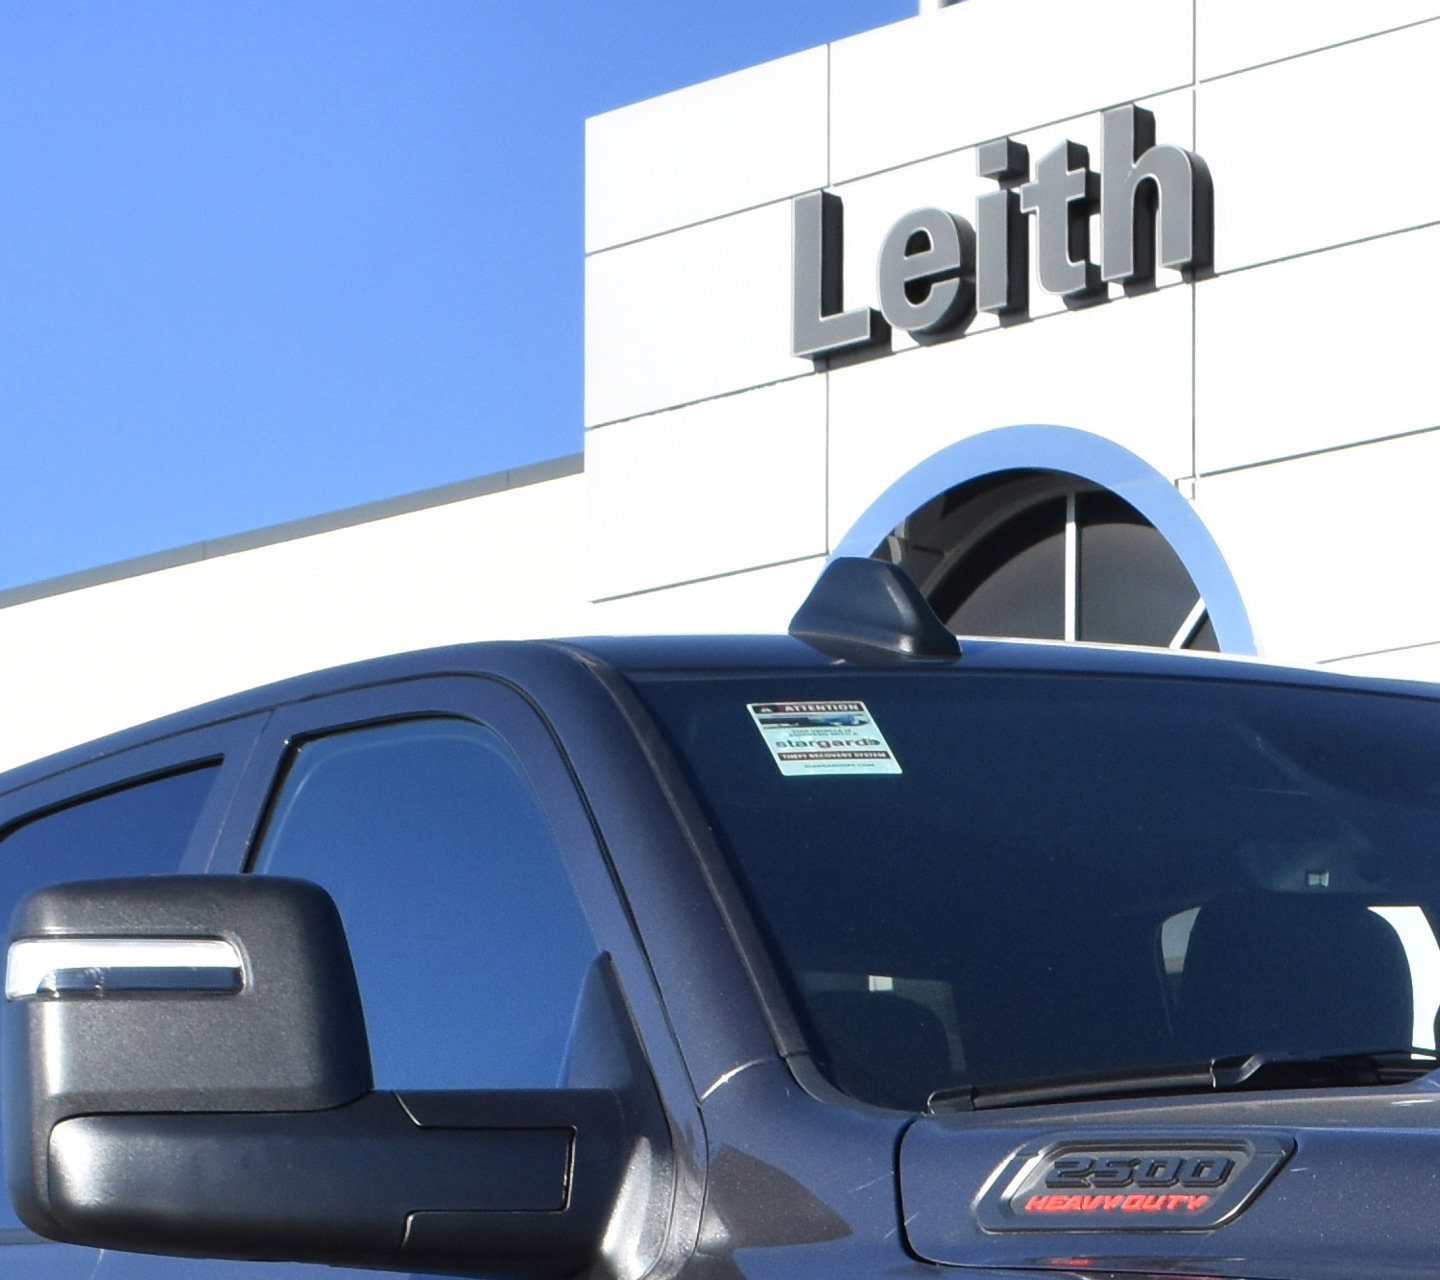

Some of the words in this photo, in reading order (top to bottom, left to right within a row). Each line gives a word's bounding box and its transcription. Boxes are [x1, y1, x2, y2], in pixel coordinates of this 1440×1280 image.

[791, 102, 1214, 372] Leith
[783, 704, 859, 713] ATTENTION
[1046, 1157, 1236, 1189] 2500
